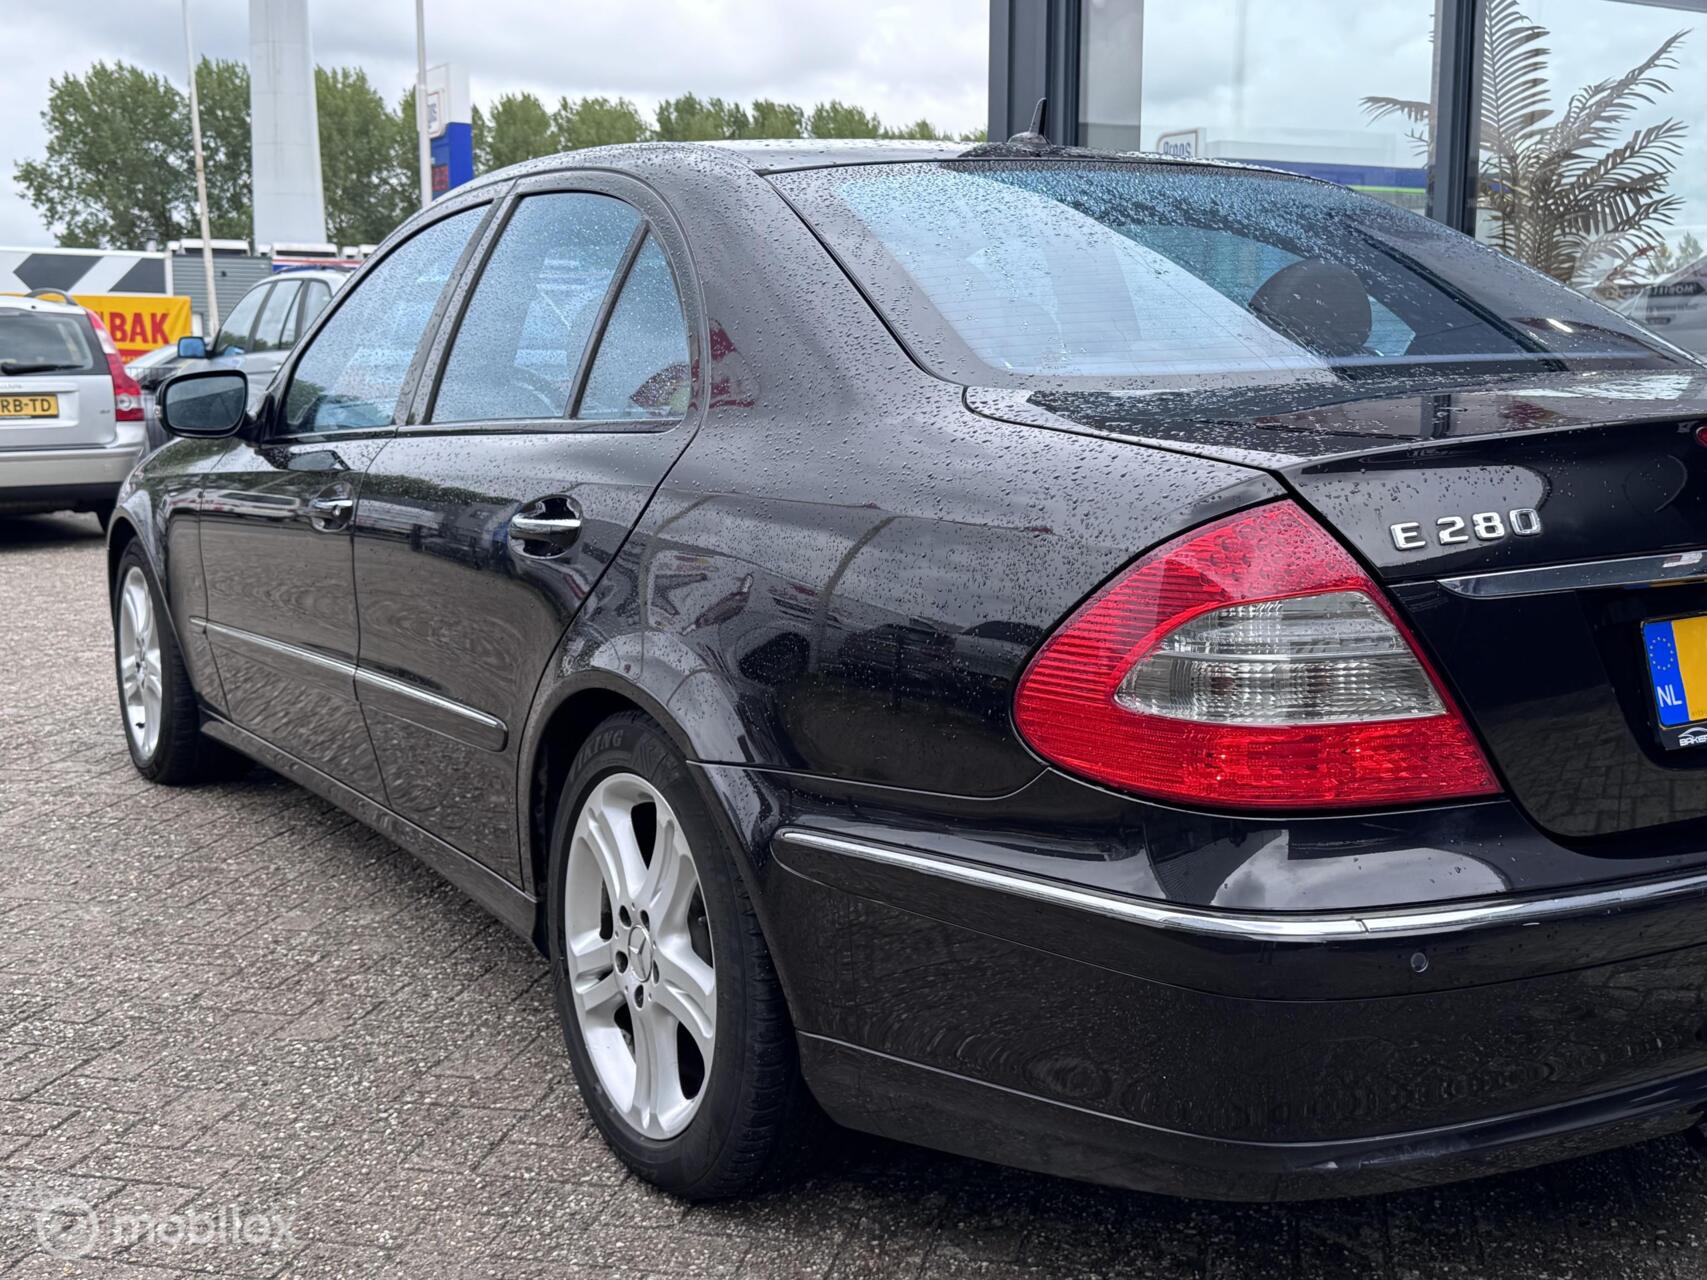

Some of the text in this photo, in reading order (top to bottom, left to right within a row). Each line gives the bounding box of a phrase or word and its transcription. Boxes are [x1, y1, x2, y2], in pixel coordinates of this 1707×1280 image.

[1389, 508, 1542, 550] E 280
[1656, 685, 1683, 708] NL
